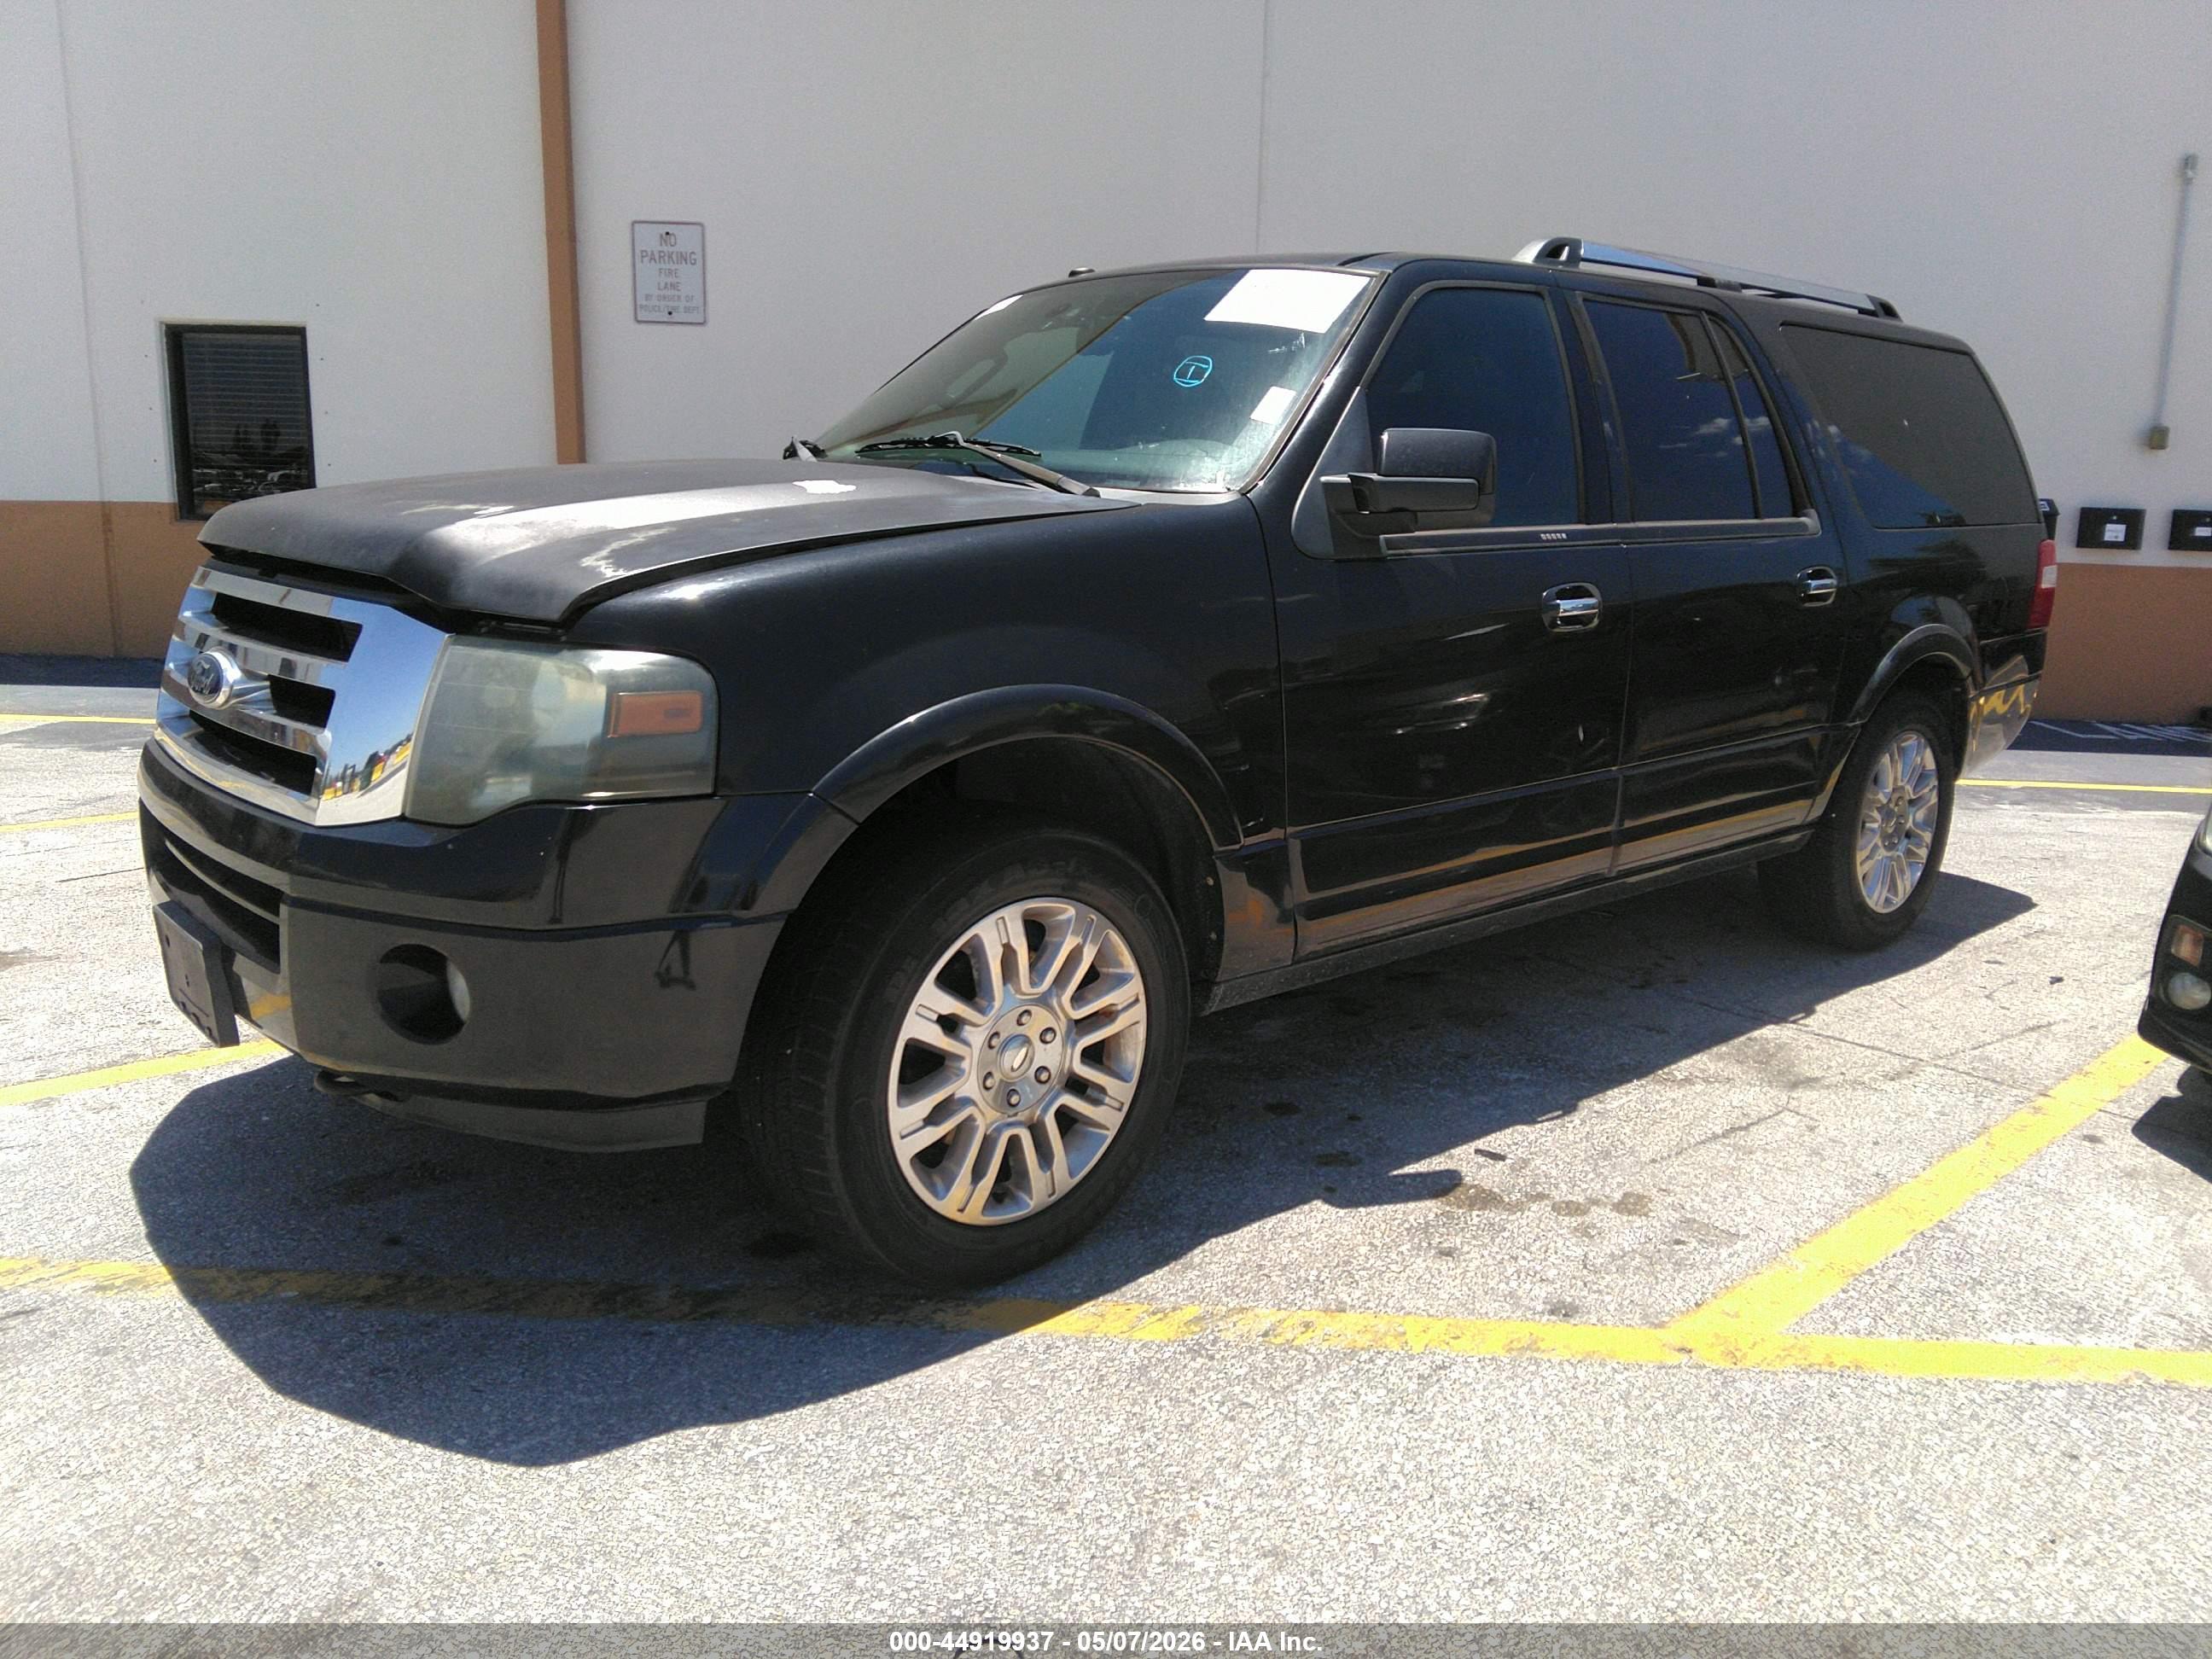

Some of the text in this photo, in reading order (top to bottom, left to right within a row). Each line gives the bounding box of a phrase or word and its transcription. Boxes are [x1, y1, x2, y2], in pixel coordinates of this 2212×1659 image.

[659, 231, 677, 247] NO
[640, 249, 697, 265] PARKING
[658, 268, 680, 278] FIRE
[657, 282, 681, 292] LANE
